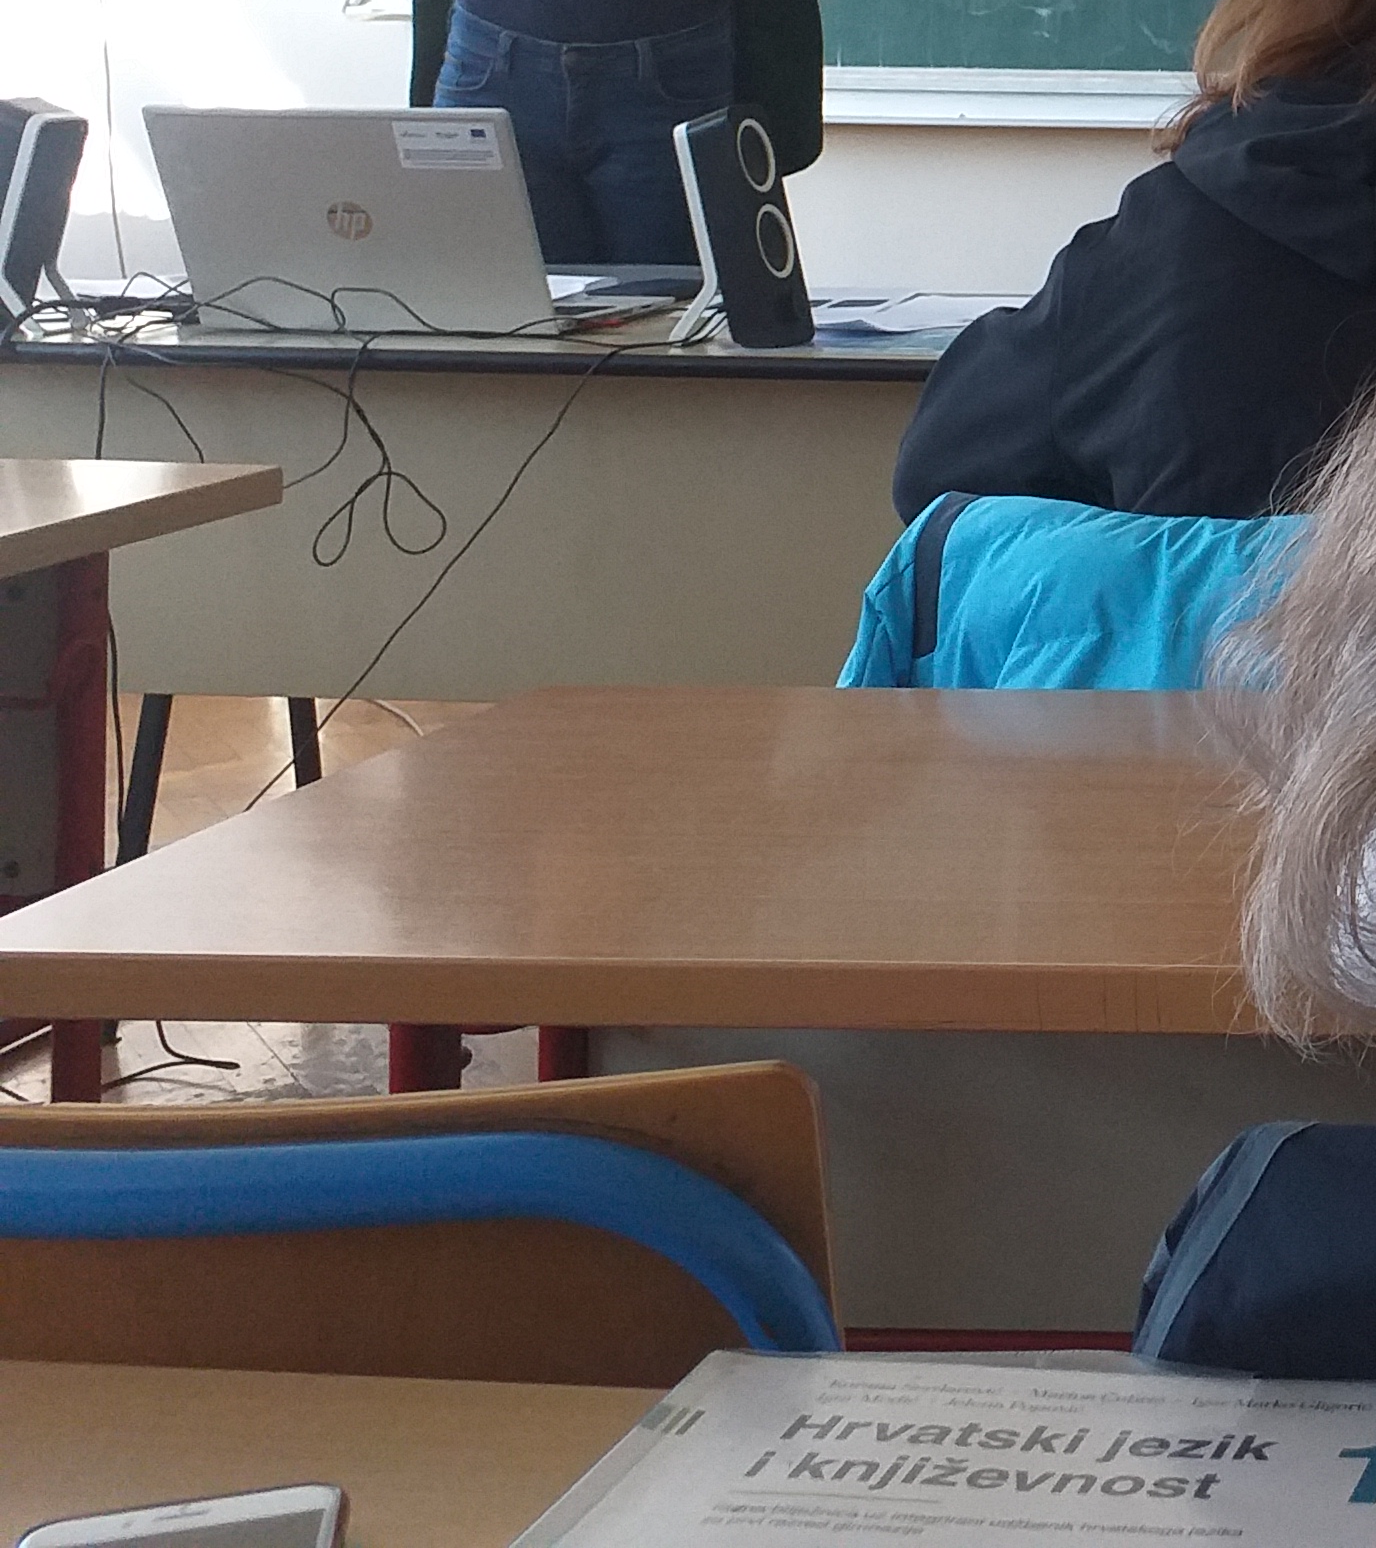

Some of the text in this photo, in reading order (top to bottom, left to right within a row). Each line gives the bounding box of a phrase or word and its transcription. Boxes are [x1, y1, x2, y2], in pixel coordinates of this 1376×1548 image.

[780, 1413, 1279, 1465] Hrvatski jezik
[745, 1450, 1221, 1500] i književnost
